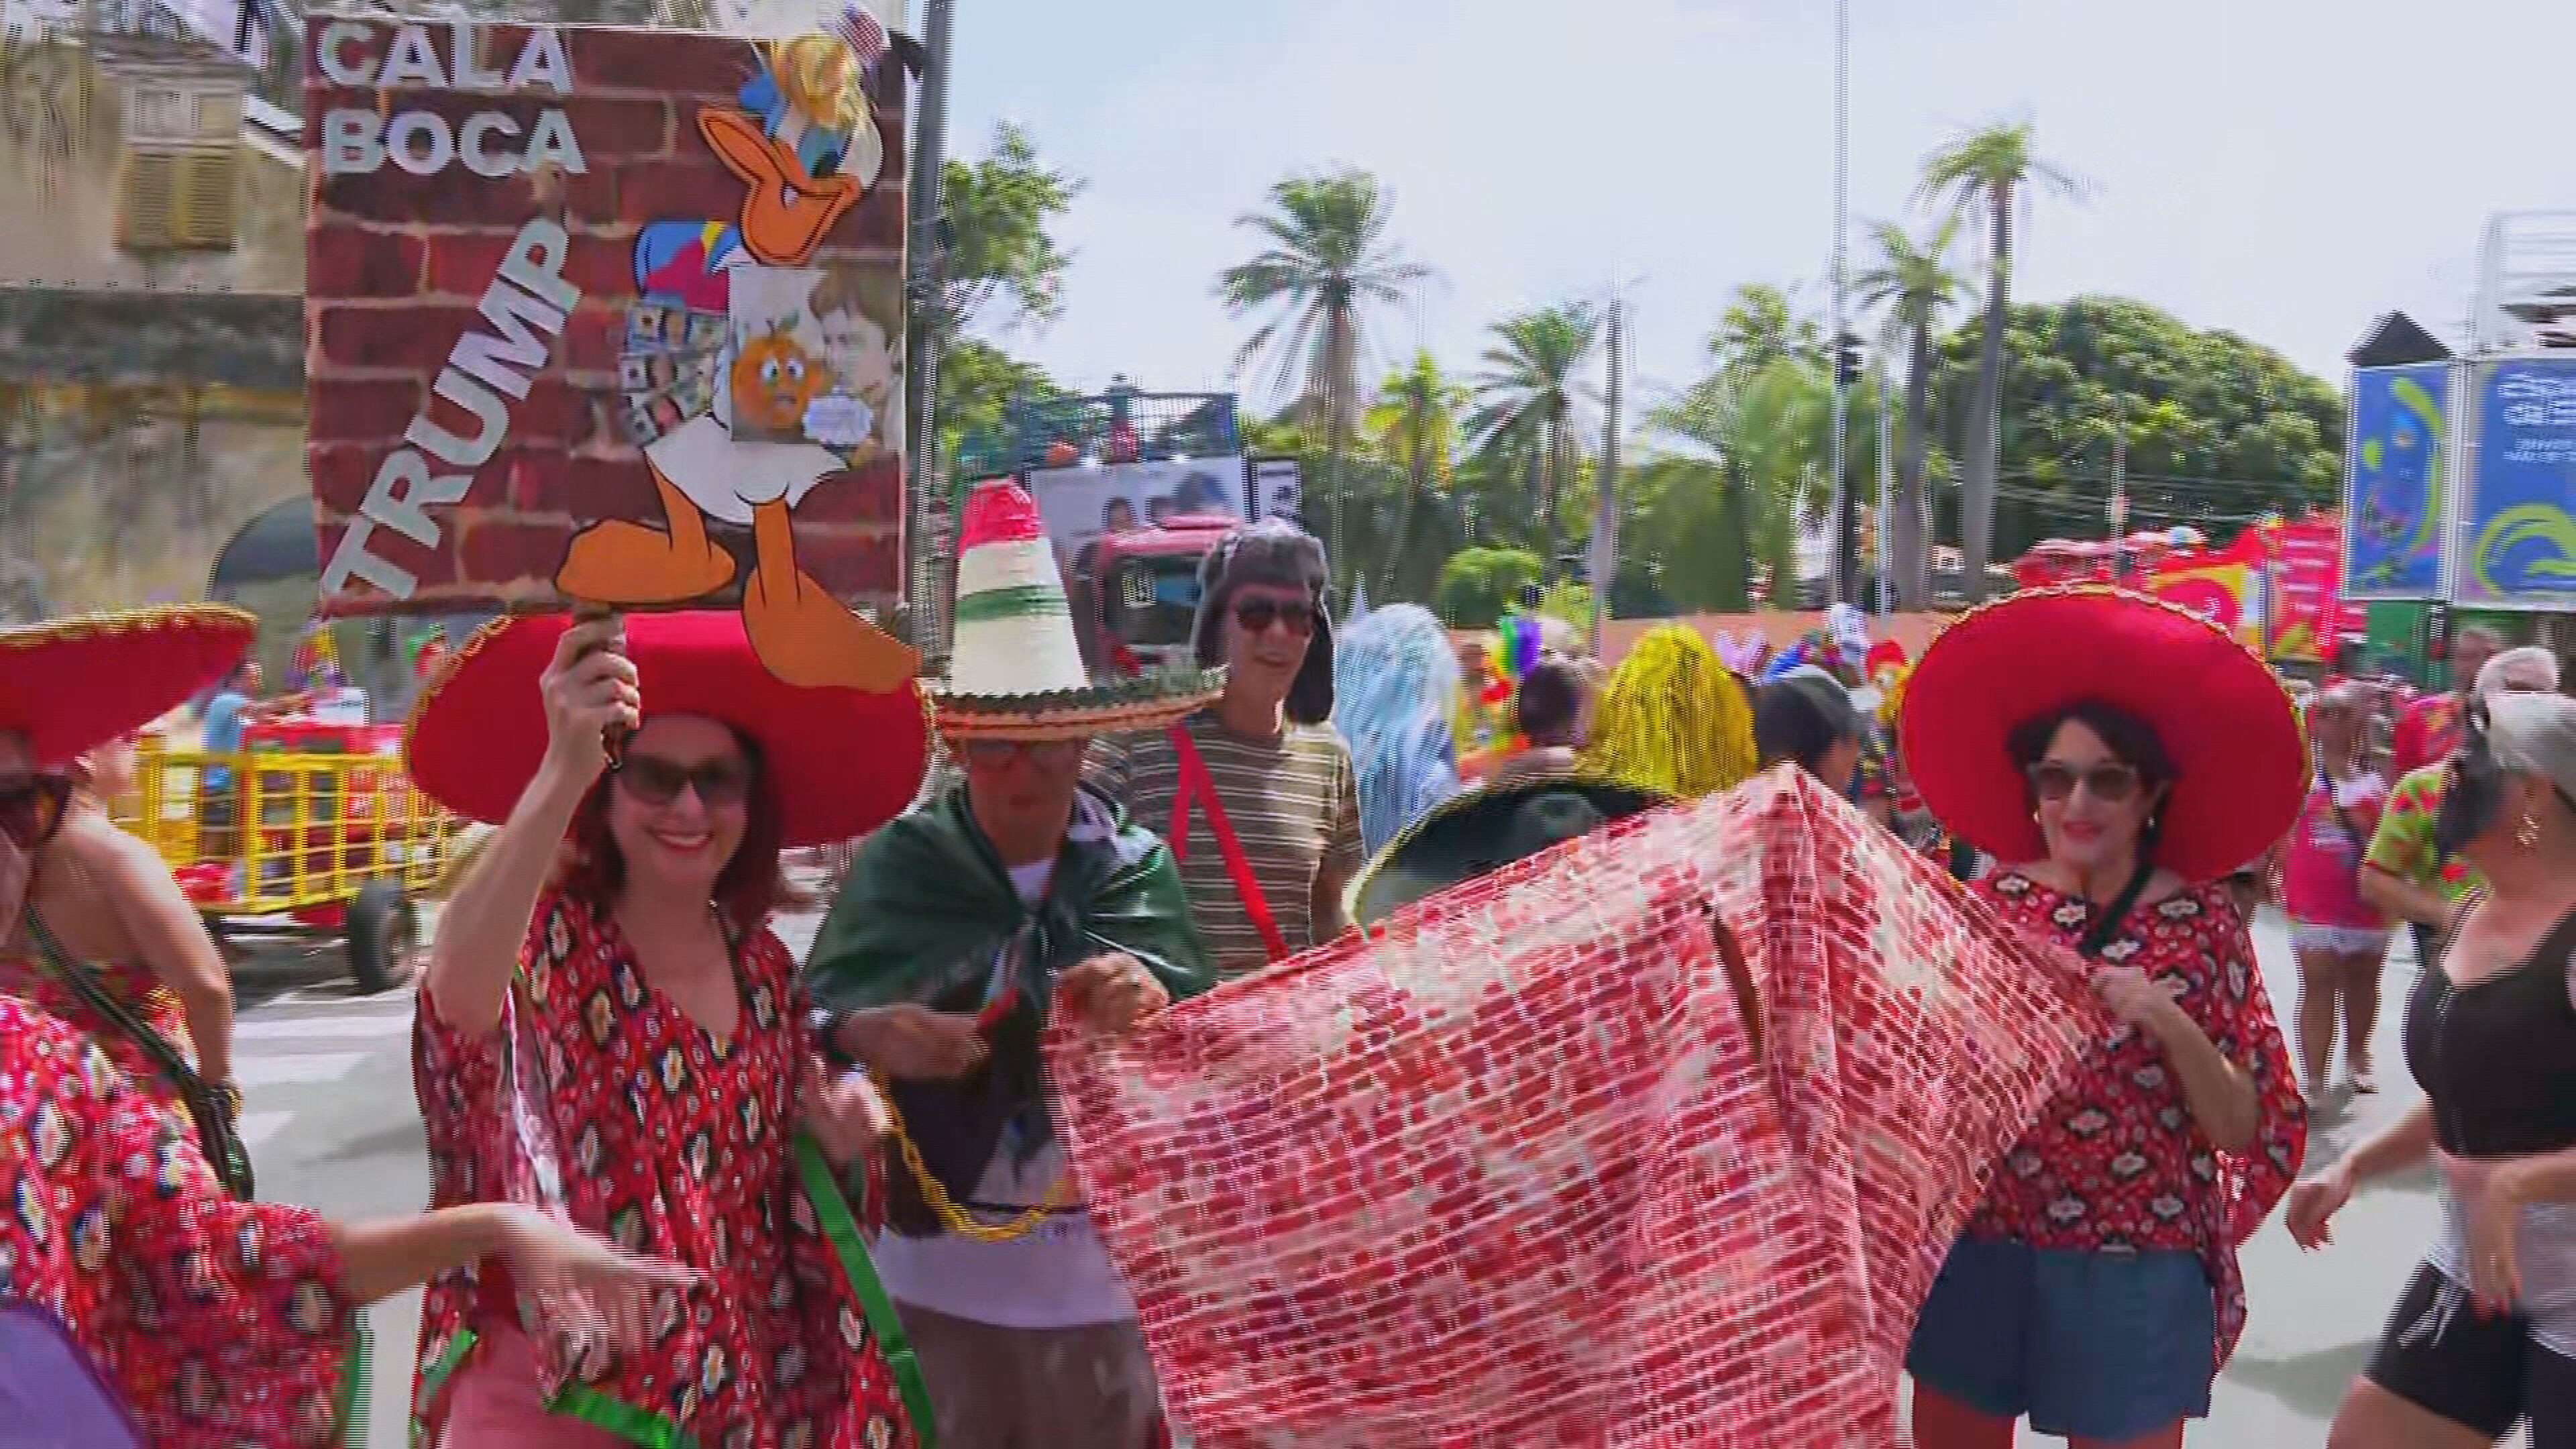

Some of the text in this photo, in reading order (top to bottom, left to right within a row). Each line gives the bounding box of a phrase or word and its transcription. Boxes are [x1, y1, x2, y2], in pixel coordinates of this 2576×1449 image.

[317, 12, 574, 95] CALA
[321, 108, 588, 177] BOCA
[321, 215, 583, 599] TRUMP
